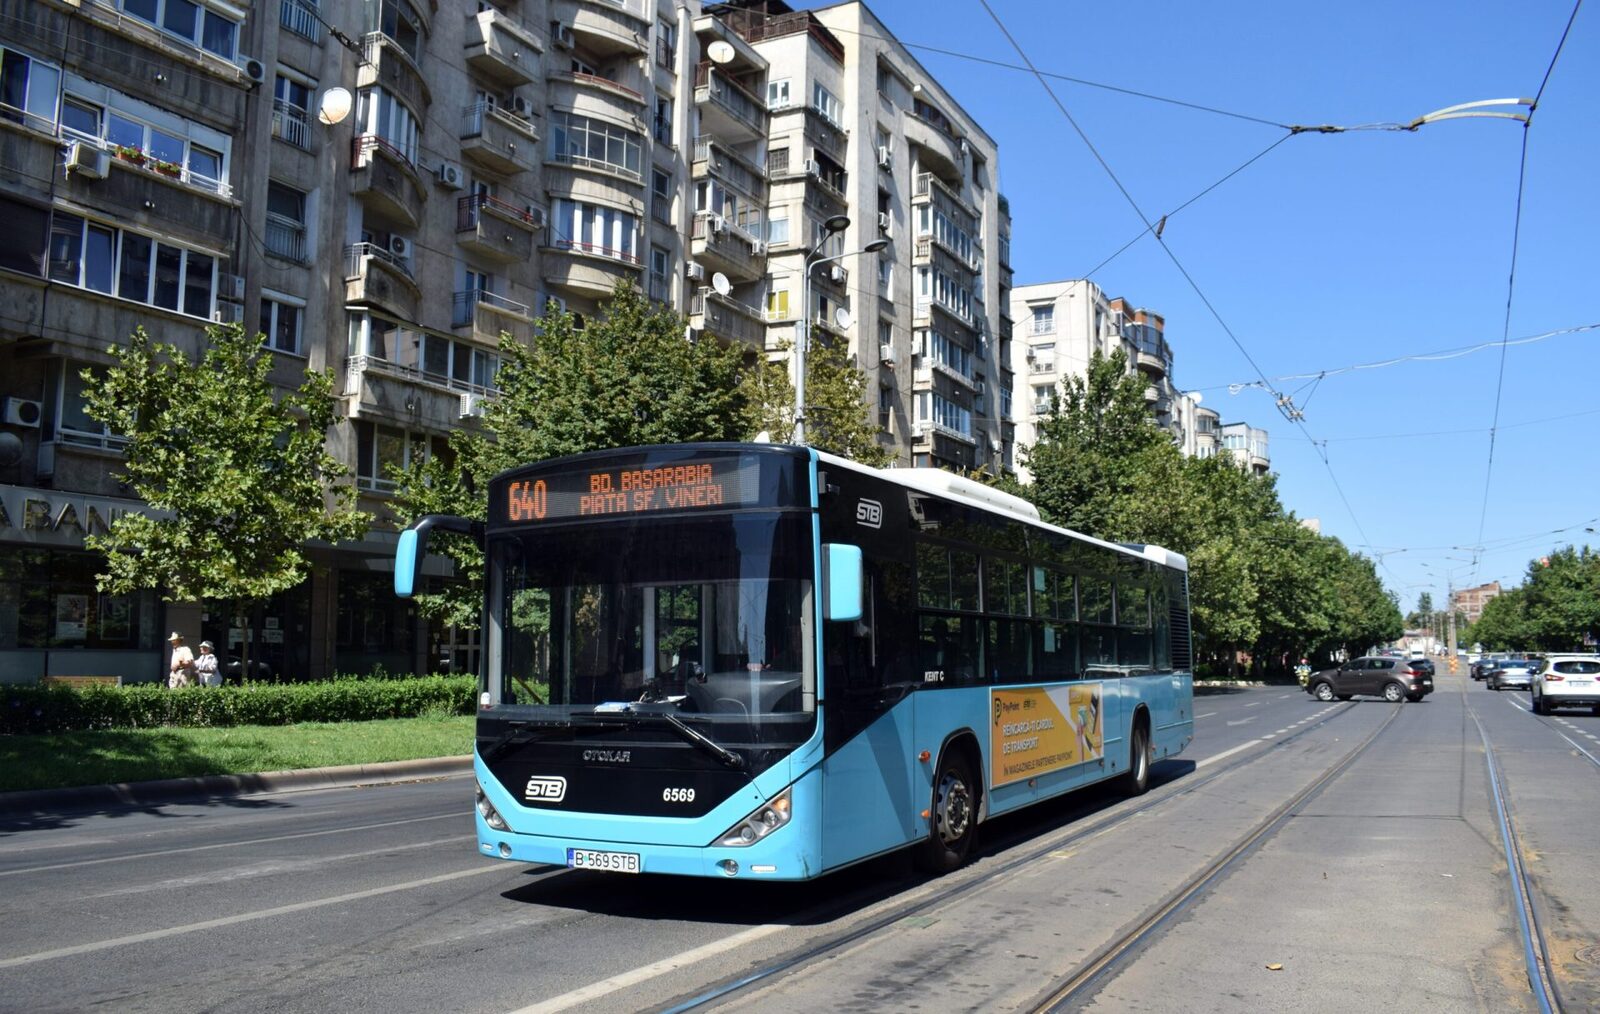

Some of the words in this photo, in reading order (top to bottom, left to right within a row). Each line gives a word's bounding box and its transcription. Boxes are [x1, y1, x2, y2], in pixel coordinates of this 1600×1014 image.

[590, 473, 615, 494] BD.
[621, 464, 712, 491] BASARABIA
[508, 480, 547, 520] 640
[580, 493, 627, 515] PIATA
[633, 490, 660, 511] SF.
[665, 484, 722, 508] VINERI
[856, 501, 881, 524] STB
[582, 750, 631, 763] OTOKAR
[525, 779, 563, 798] STB
[663, 788, 695, 802] 6569
